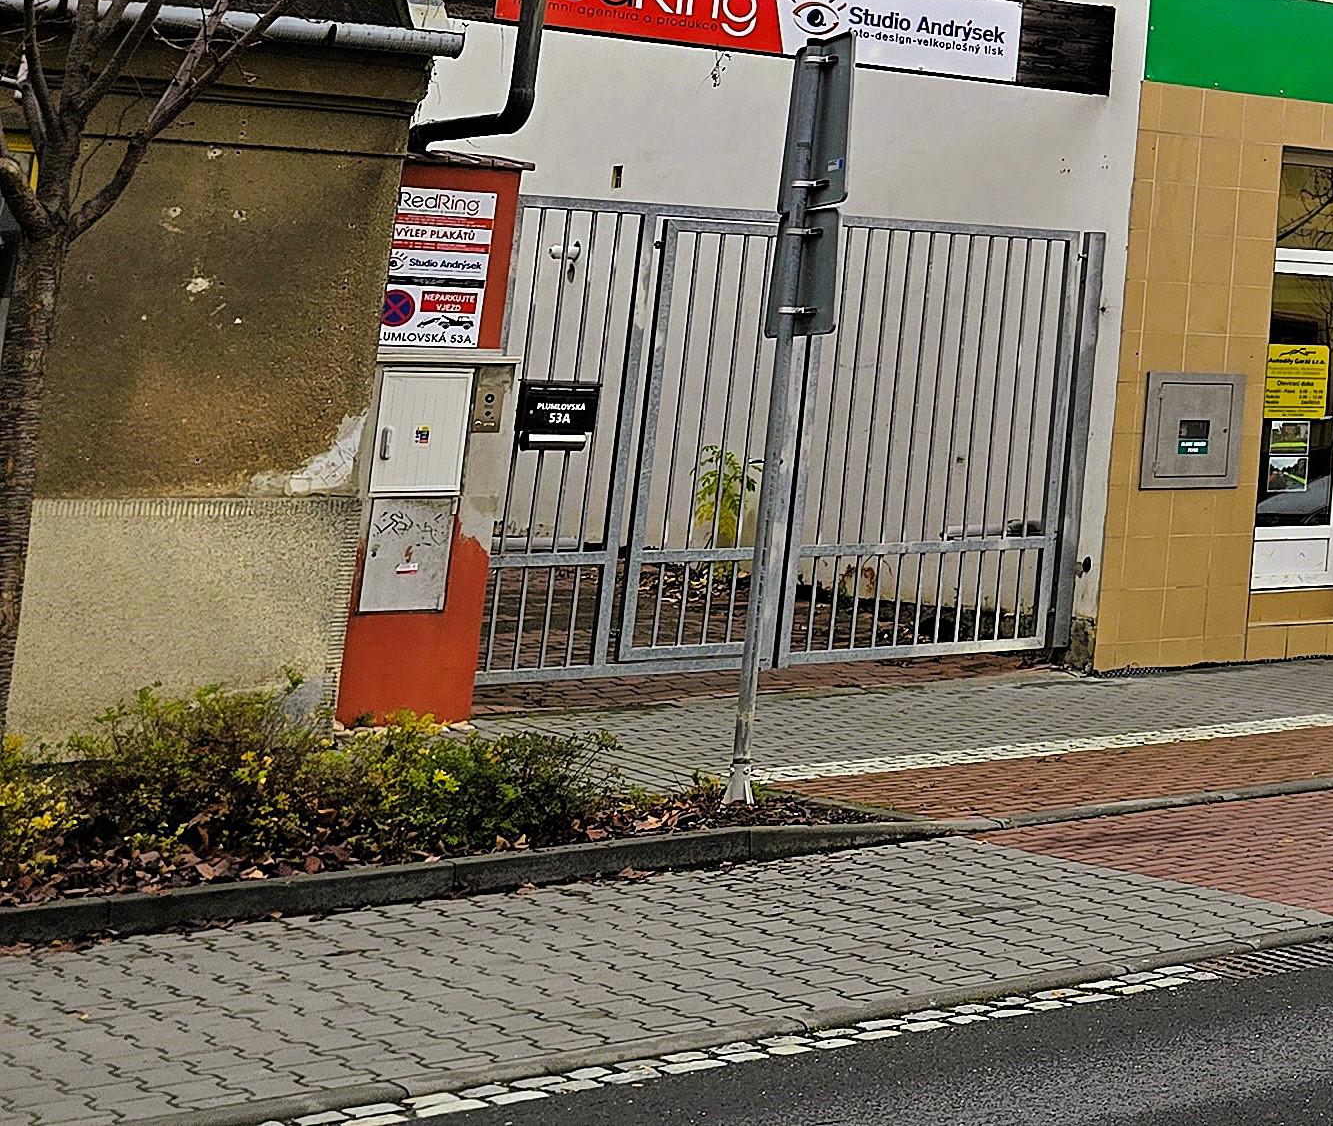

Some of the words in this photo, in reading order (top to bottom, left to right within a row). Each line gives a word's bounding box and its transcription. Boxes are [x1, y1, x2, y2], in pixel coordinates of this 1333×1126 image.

[577, 4, 640, 23] agentura
[643, 15, 652, 24] a
[656, 15, 719, 32] produkce
[849, 6, 912, 32] Studio
[916, 16, 1006, 44] Andrýsek
[399, 191, 481, 216] RedRing
[395, 226, 428, 238] VÝLEP
[430, 229, 476, 241] PLAKÁTŮ
[409, 258, 438, 268] Studio
[439, 259, 482, 270] Andrýsek
[423, 294, 476, 303] NEPARKUJTE
[436, 304, 461, 312] VJEZD
[450, 334, 472, 344] 53A
[548, 412, 571, 424] 53A
